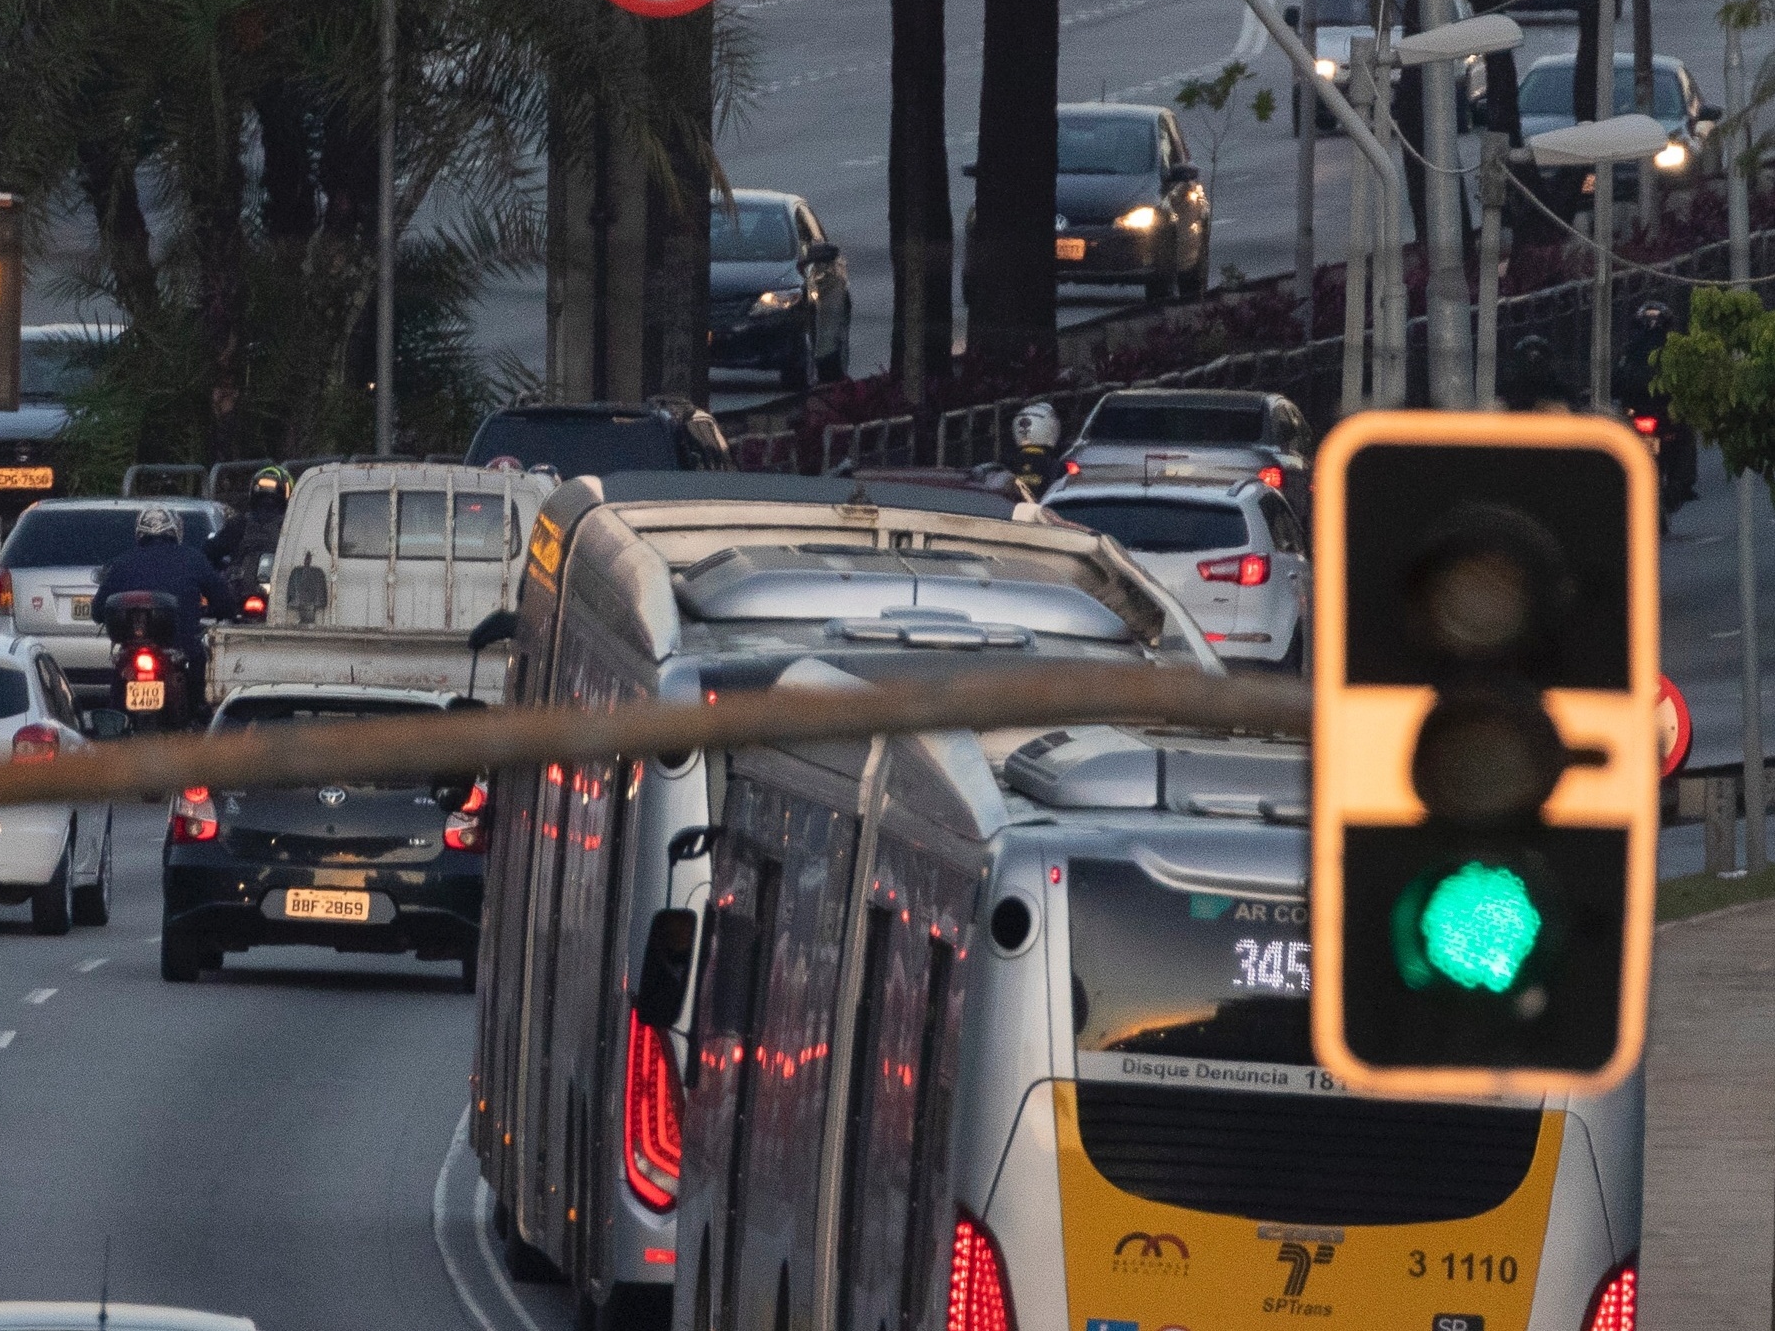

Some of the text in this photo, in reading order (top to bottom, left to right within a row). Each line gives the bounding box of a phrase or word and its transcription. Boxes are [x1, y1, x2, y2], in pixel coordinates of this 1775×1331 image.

[1235, 905, 1267, 922] AR
[1122, 1057, 1190, 1079] Disque
[1195, 1063, 1289, 1087] Denúncia
[1409, 1250, 1518, 1284] 3 1110
[1263, 1298, 1333, 1317] SPTrans
